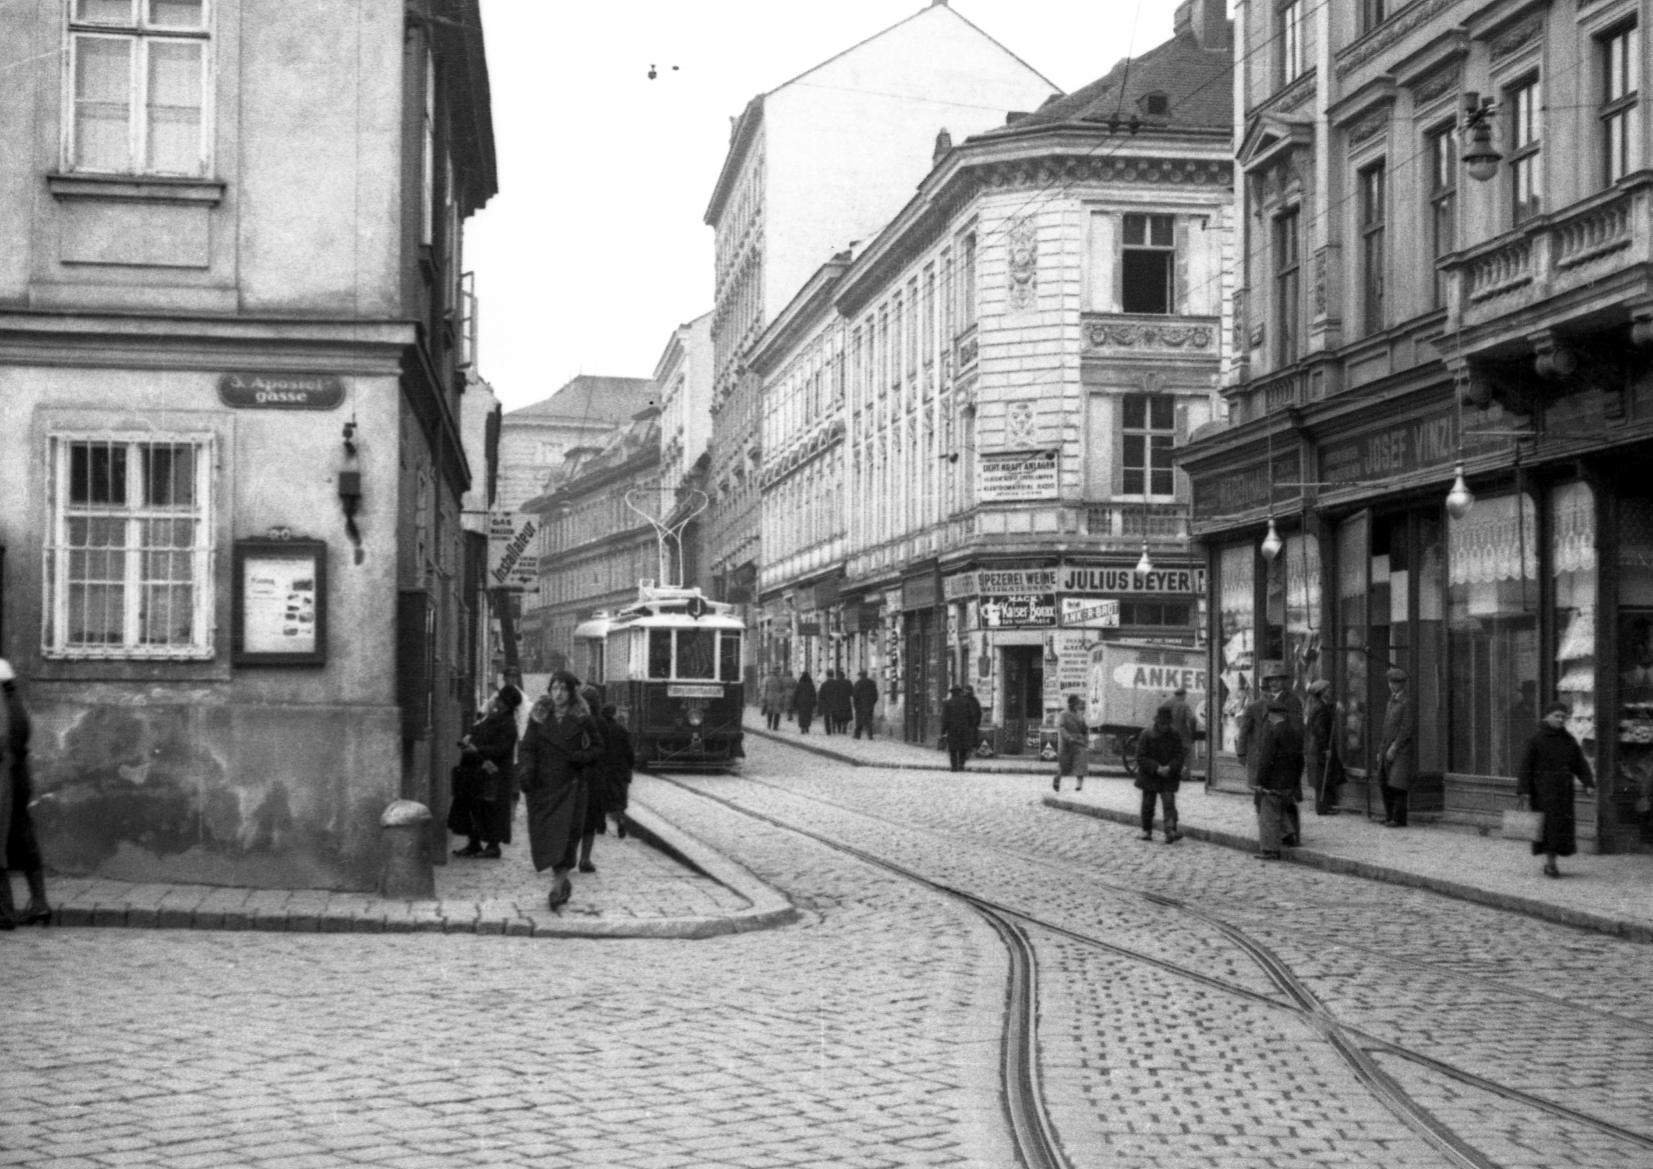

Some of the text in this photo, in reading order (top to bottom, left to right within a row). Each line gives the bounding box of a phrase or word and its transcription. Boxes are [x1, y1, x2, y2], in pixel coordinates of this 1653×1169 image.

[255, 391, 308, 404] gasse
[1364, 428, 1407, 474] JOSEF
[1024, 461, 1056, 470] ANLAGEN
[491, 521, 536, 584] Installateur
[978, 572, 1023, 586] SPEZEREI
[1025, 571, 1056, 585] WEINE
[1064, 570, 1129, 590] JULIUS
[1133, 570, 1190, 591] BEYER
[692, 598, 701, 616] J
[1063, 602, 1119, 625] ANKR-BROT
[1133, 666, 1207, 691] ANKER
